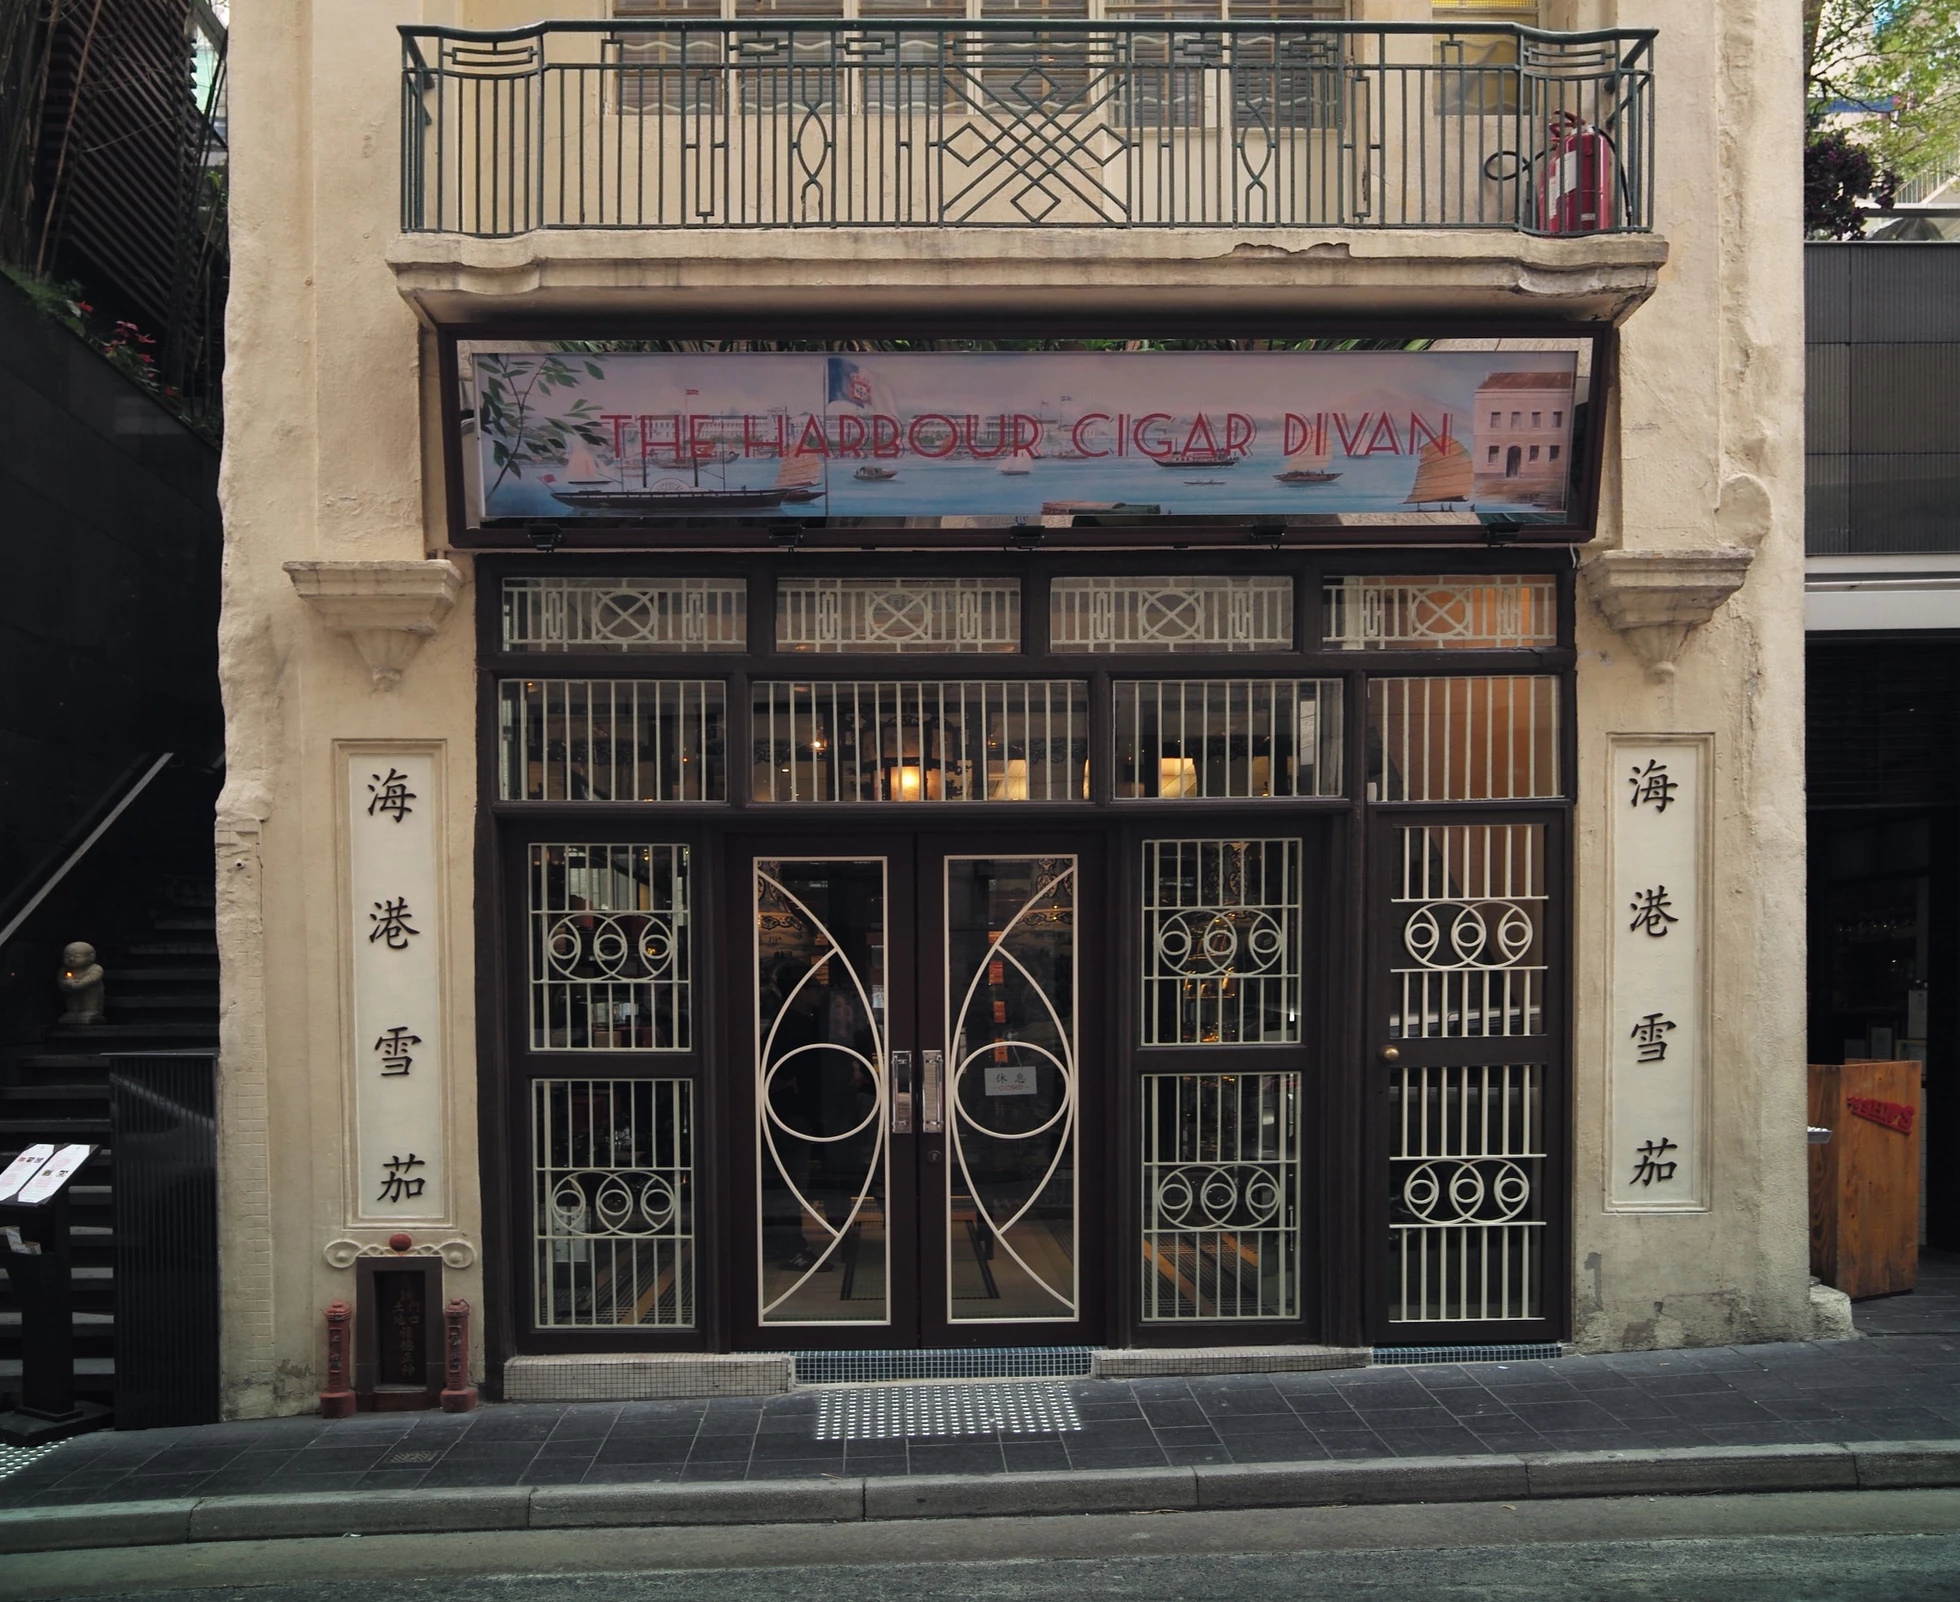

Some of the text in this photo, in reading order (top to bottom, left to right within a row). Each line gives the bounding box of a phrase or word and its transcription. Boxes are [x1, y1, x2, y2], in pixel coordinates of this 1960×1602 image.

[600, 411, 1453, 459] THE HARBOUR CIGAR DIVAN
[367, 768, 426, 1203] 海港雪茄
[1628, 759, 1679, 1187] 海港雪茄
